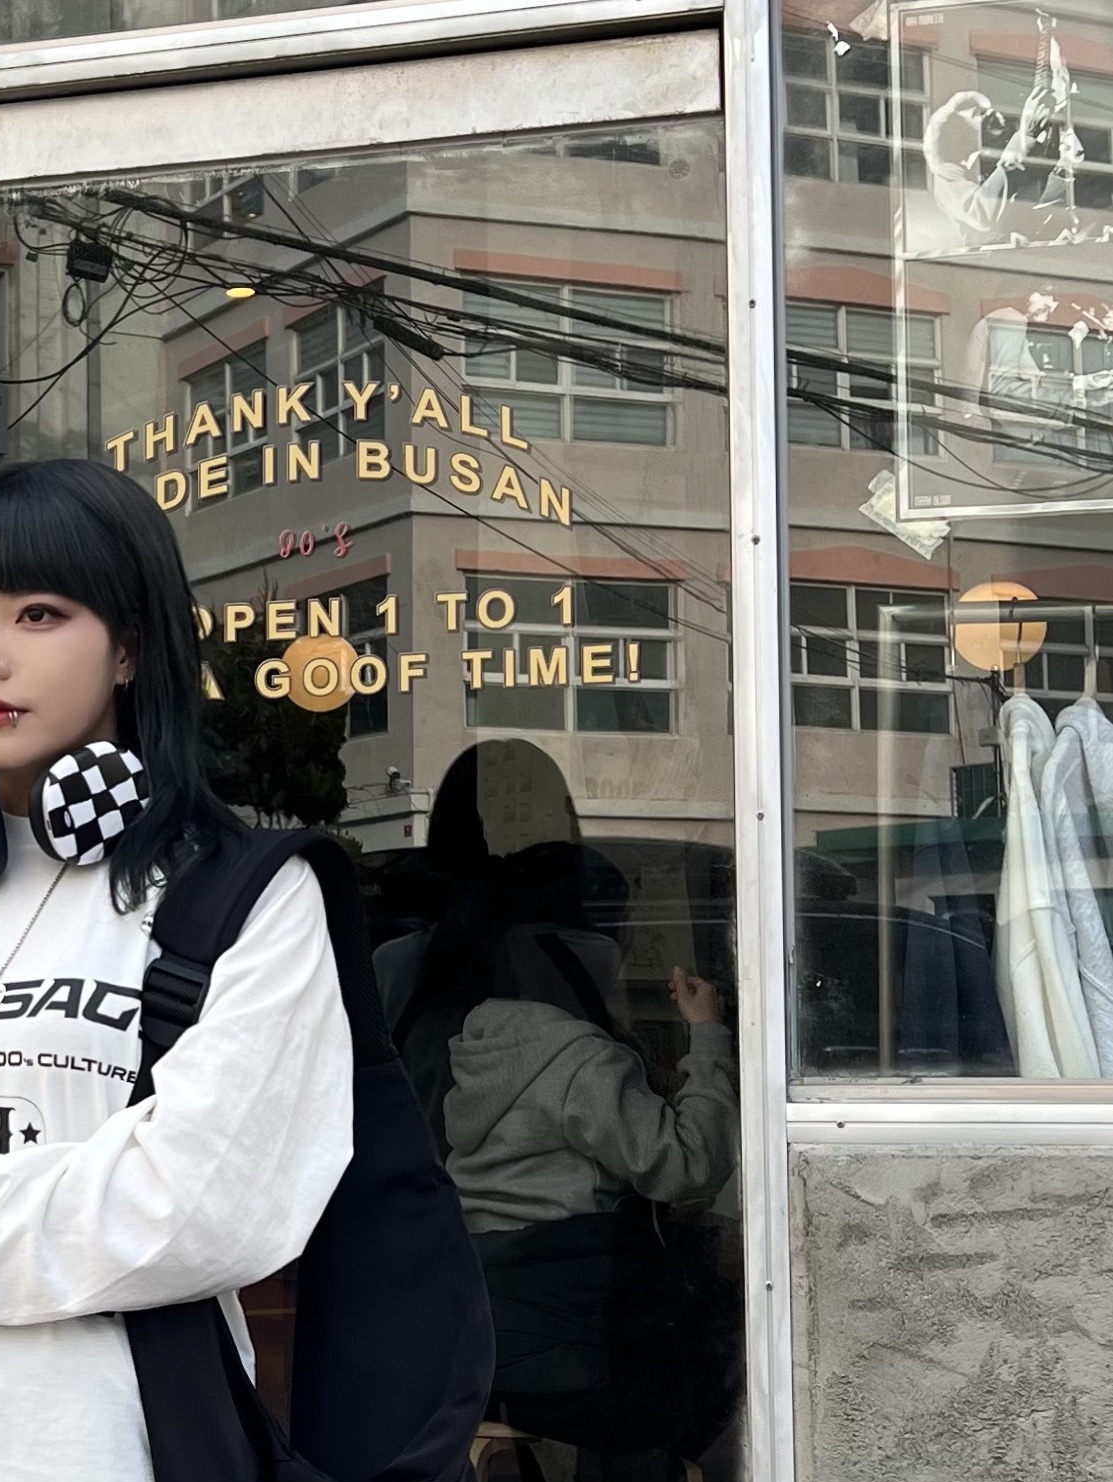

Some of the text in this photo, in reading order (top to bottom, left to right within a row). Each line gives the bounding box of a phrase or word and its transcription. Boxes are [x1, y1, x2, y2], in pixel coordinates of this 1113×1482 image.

[104, 379, 534, 474] THANK Y'ALL
[263, 440, 325, 488] IN
[355, 438, 576, 529] BUSAN
[375, 595, 402, 637] 1
[436, 588, 518, 632] TO
[551, 585, 576, 628] 1
[254, 650, 429, 700] GOOF
[460, 640, 643, 690] TIME!
[37, 1052, 138, 1084] CULTURE
